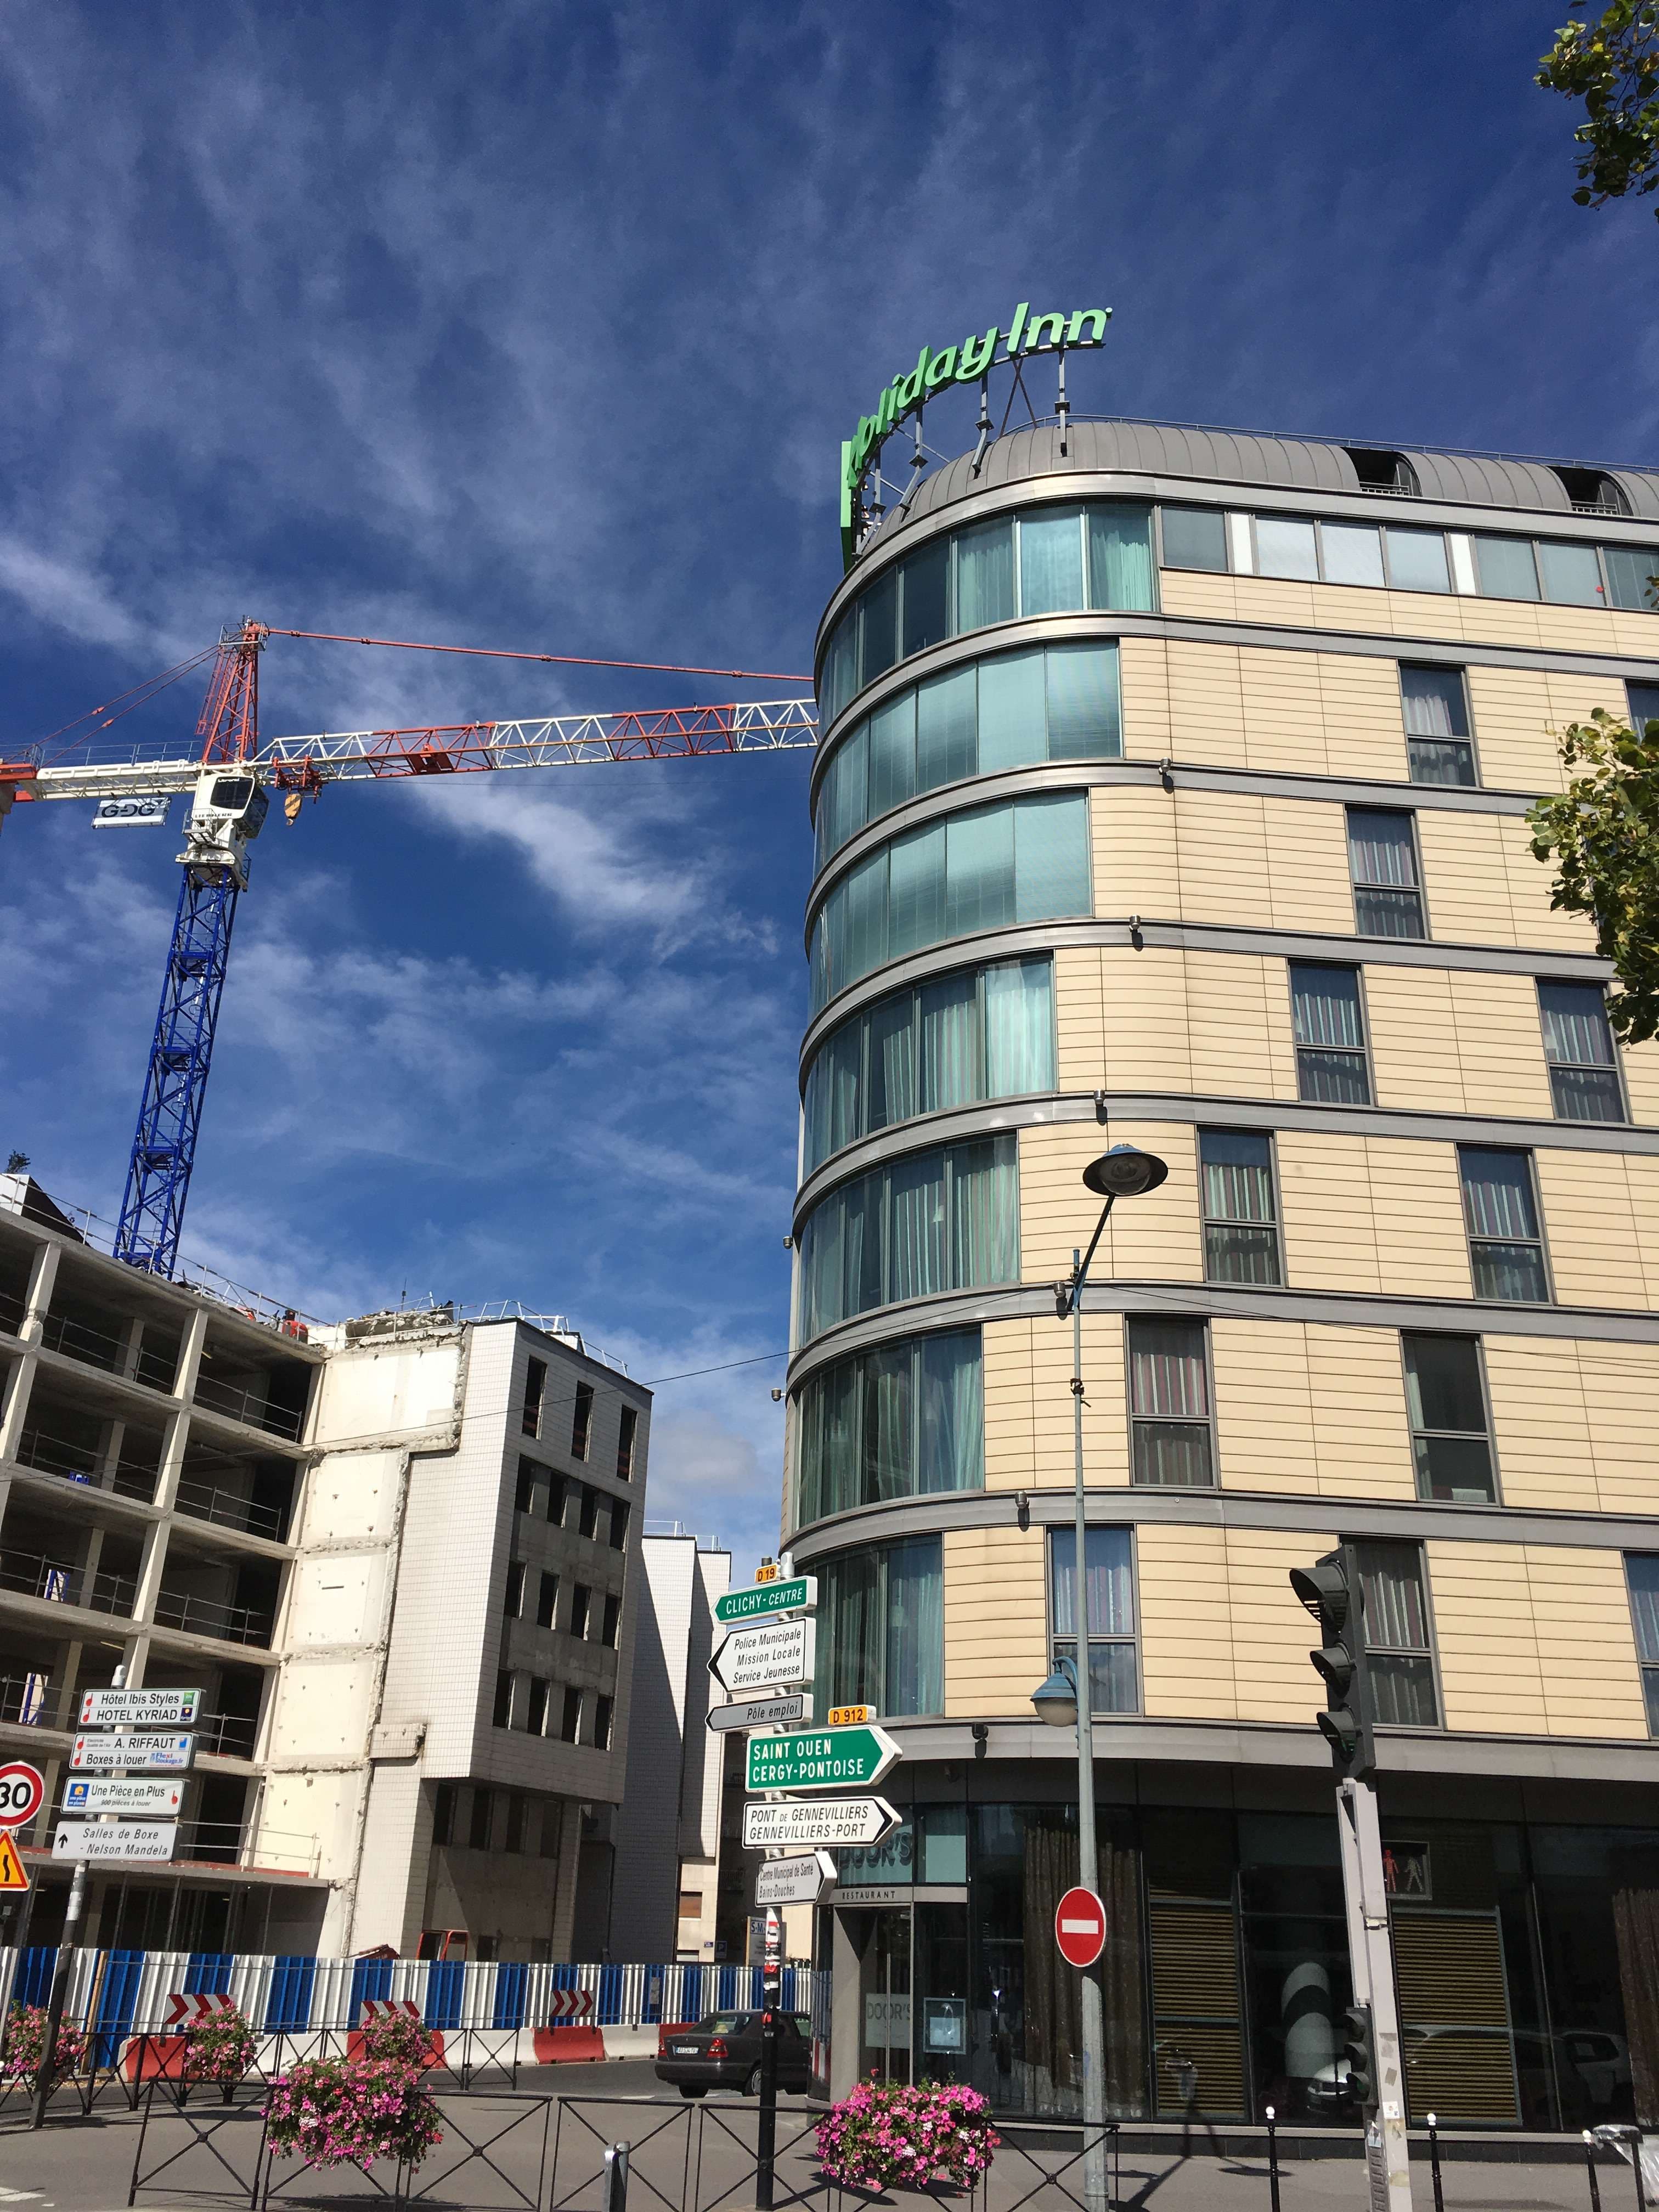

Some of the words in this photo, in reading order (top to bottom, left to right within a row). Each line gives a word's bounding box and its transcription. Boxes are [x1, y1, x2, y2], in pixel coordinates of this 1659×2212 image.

[1006, 302, 1107, 354] Inn
[757, 1570, 763, 1582] D
[765, 1567, 775, 1580] 19
[734, 1638, 757, 1650] Police
[759, 1628, 801, 1646] Municipale
[737, 1652, 769, 1667] Mission
[772, 1646, 800, 1661] Locale
[733, 1670, 760, 1684] Service
[764, 1664, 800, 1679] Jeunesse
[101, 1694, 126, 1705] Hôtel
[129, 1694, 146, 1704] Ibis
[150, 1693, 179, 1707] Styles
[97, 1710, 132, 1720] HOTEL
[136, 1709, 178, 1720] KYRIAD
[747, 1706, 765, 1720] Pôle
[769, 1702, 798, 1718] emploi
[833, 1711, 839, 1724] D
[844, 1708, 864, 1723] 912
[114, 1737, 125, 1748] A.
[128, 1737, 176, 1748] RIFFAUT
[753, 1742, 791, 1761] SAINT
[797, 1739, 832, 1757] OUEN
[86, 1753, 114, 1765] Boxes
[116, 1753, 121, 1765] à
[123, 1754, 147, 1765] louer
[753, 1758, 864, 1782] CERGY-PONTOISE
[0, 1782, 31, 1809] 30
[91, 1785, 107, 1796] Une
[110, 1785, 131, 1797] Pièce
[134, 1788, 144, 1797] en
[146, 1786, 165, 1797] Plus
[751, 1809, 777, 1823] PONT
[779, 1814, 788, 1822] DE
[792, 1805, 869, 1821] GENNEVILLIERS
[83, 1828, 114, 1838] Salles
[119, 1829, 130, 1839] de
[134, 1829, 159, 1839] Boxe
[749, 1823, 866, 1839] GENNEVILLIERS-PORT
[87, 1844, 121, 1854] Nelson
[125, 1844, 168, 1855] Mandela
[760, 1869, 773, 1882] Centre
[774, 1864, 794, 1882] Municipal
[794, 1864, 800, 1877] de
[801, 1862, 814, 1876] Santé
[759, 1883, 795, 1899] Bains-Douches
[842, 1891, 895, 1900] RESTAURANT
